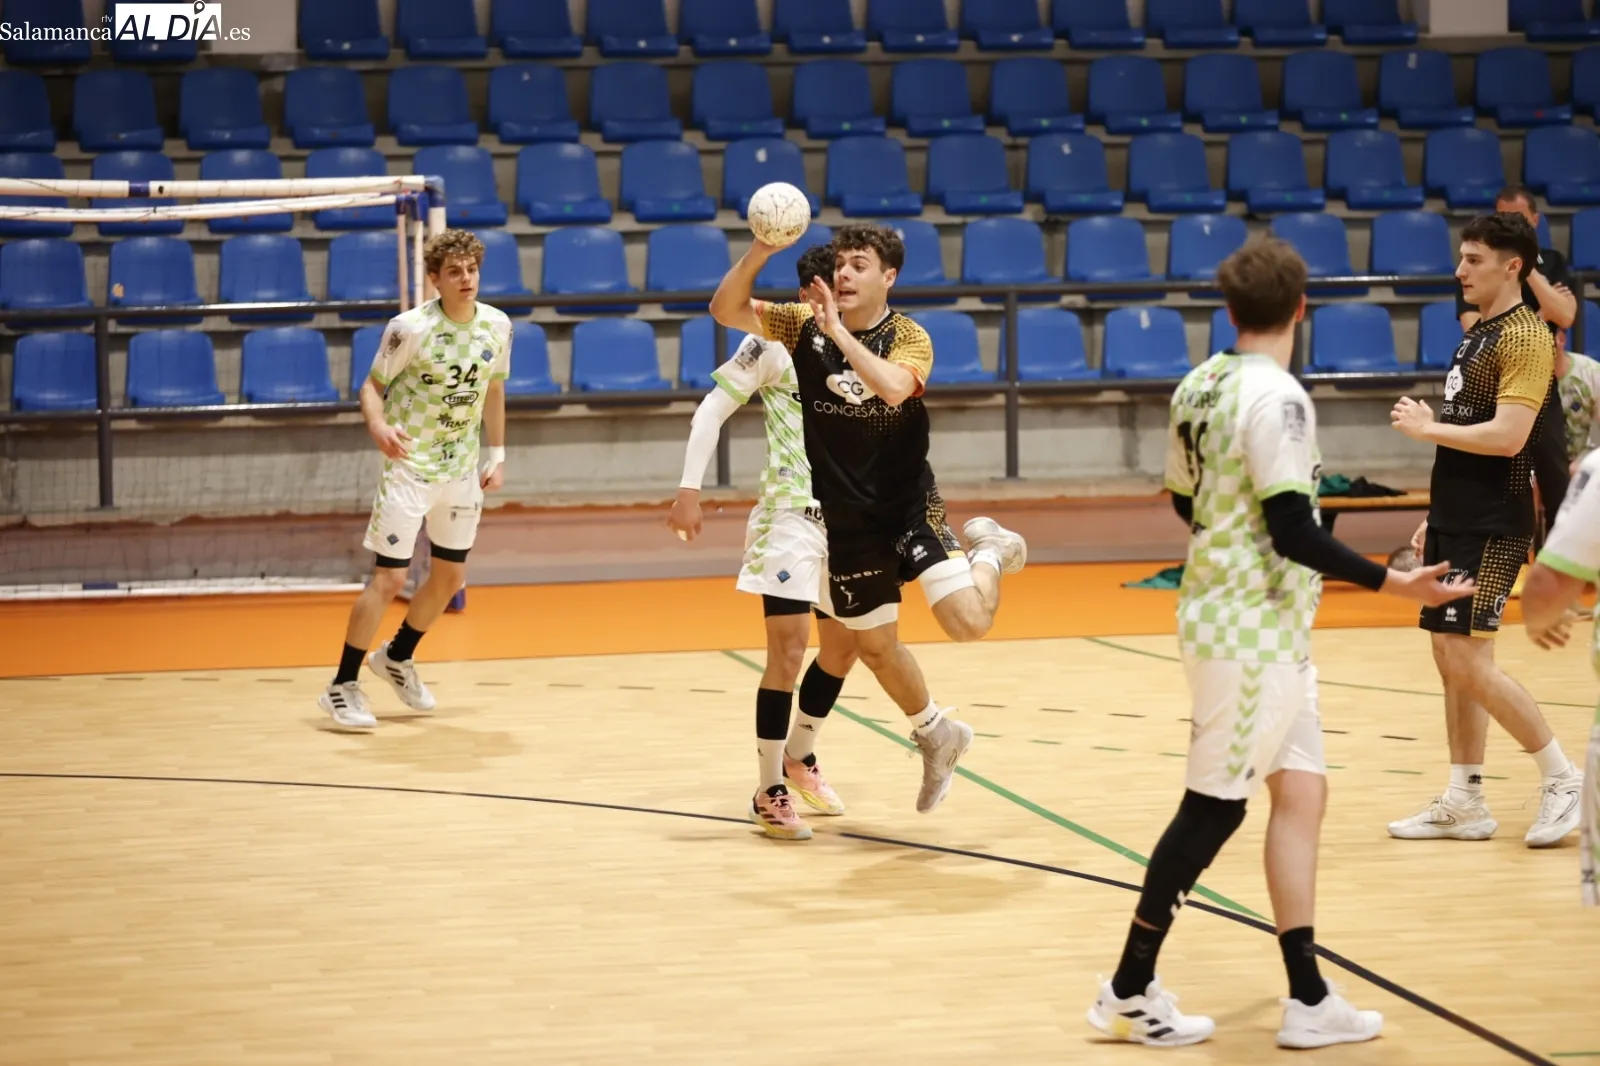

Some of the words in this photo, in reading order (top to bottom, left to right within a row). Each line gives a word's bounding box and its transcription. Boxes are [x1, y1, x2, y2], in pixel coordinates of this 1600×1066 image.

[447, 363, 478, 389] 34
[837, 381, 864, 396] CG
[813, 400, 879, 418] CONGESA
[1457, 404, 1473, 417] XXI
